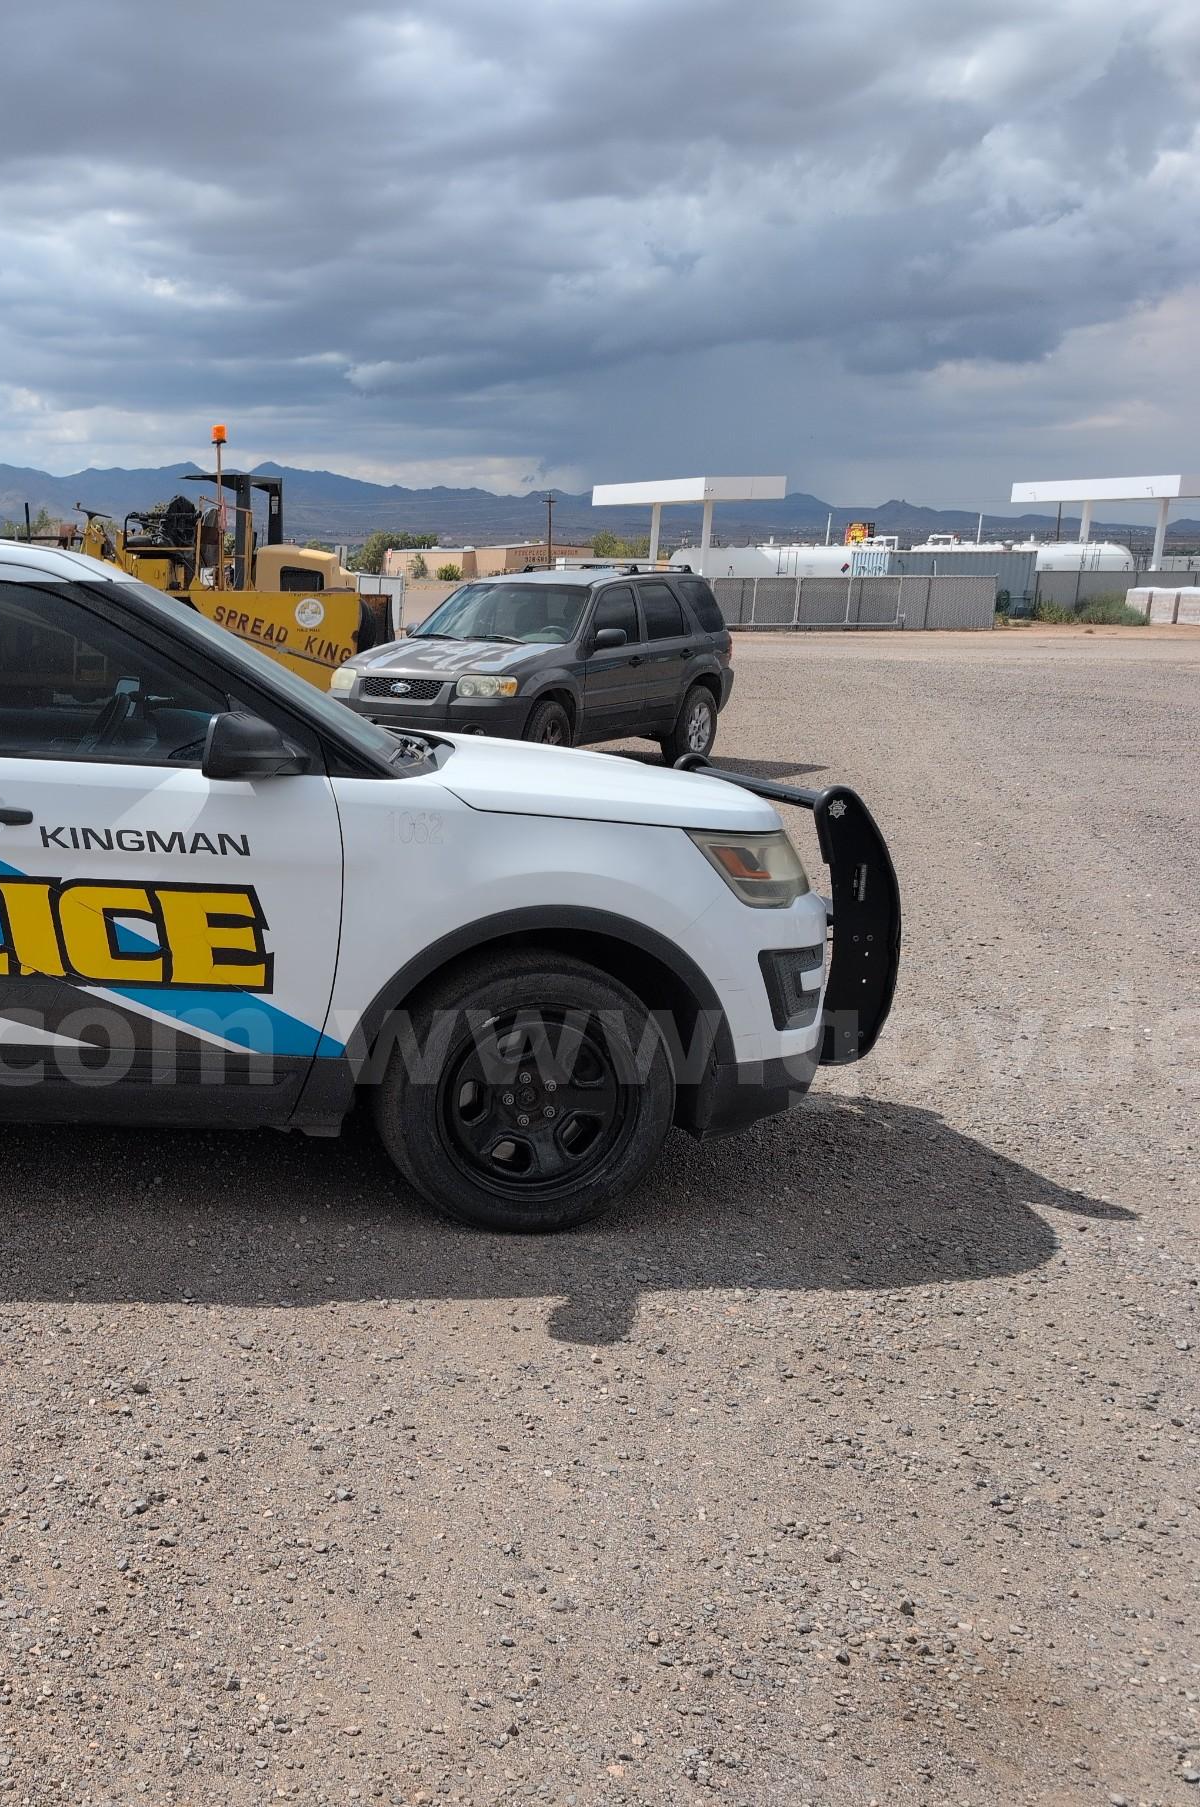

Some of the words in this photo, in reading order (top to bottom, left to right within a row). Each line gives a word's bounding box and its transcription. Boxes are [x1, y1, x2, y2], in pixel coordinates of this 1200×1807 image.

[213, 605, 289, 644] SPREAD
[304, 635, 352, 663] KING
[39, 825, 251, 857] KINGMAN
